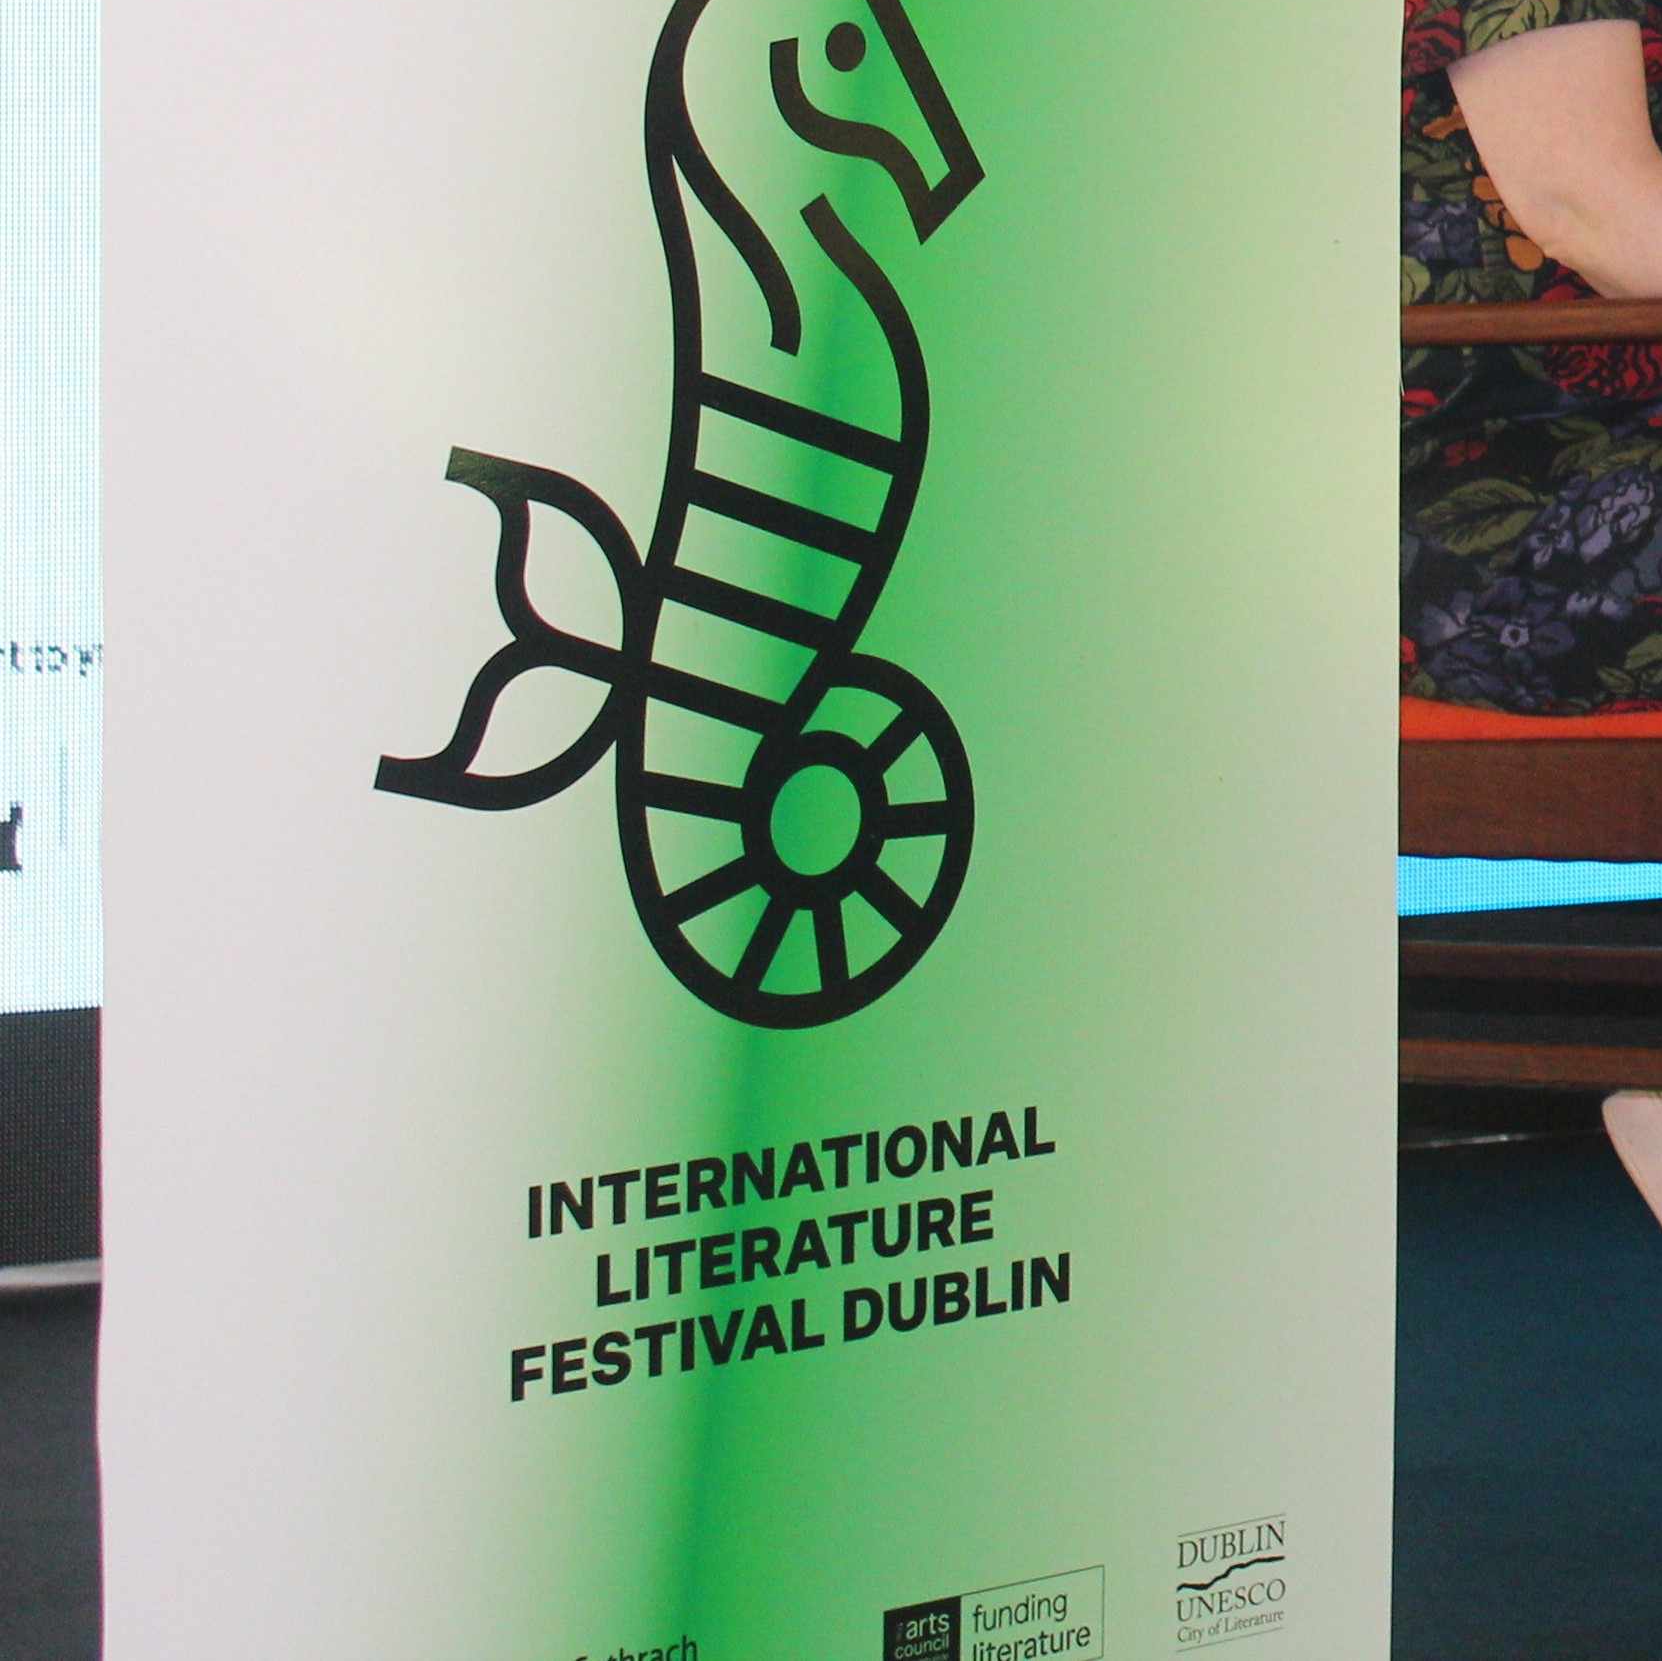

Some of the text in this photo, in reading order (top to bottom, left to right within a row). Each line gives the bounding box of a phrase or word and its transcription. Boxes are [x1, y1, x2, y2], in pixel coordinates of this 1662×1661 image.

[527, 1105, 1056, 1238] INTERNATIONAL
[594, 1188, 995, 1307] LITERATURE
[510, 1252, 1073, 1402] FESTIVAL DUBLIN
[1177, 1520, 1286, 1569] DUBLIN
[972, 1594, 1068, 1633] funding
[1176, 1578, 1286, 1623] UNESCO
[894, 1635, 950, 1660] council
[905, 1612, 950, 1640] arts
[1176, 1610, 1285, 1643] City of Literature
